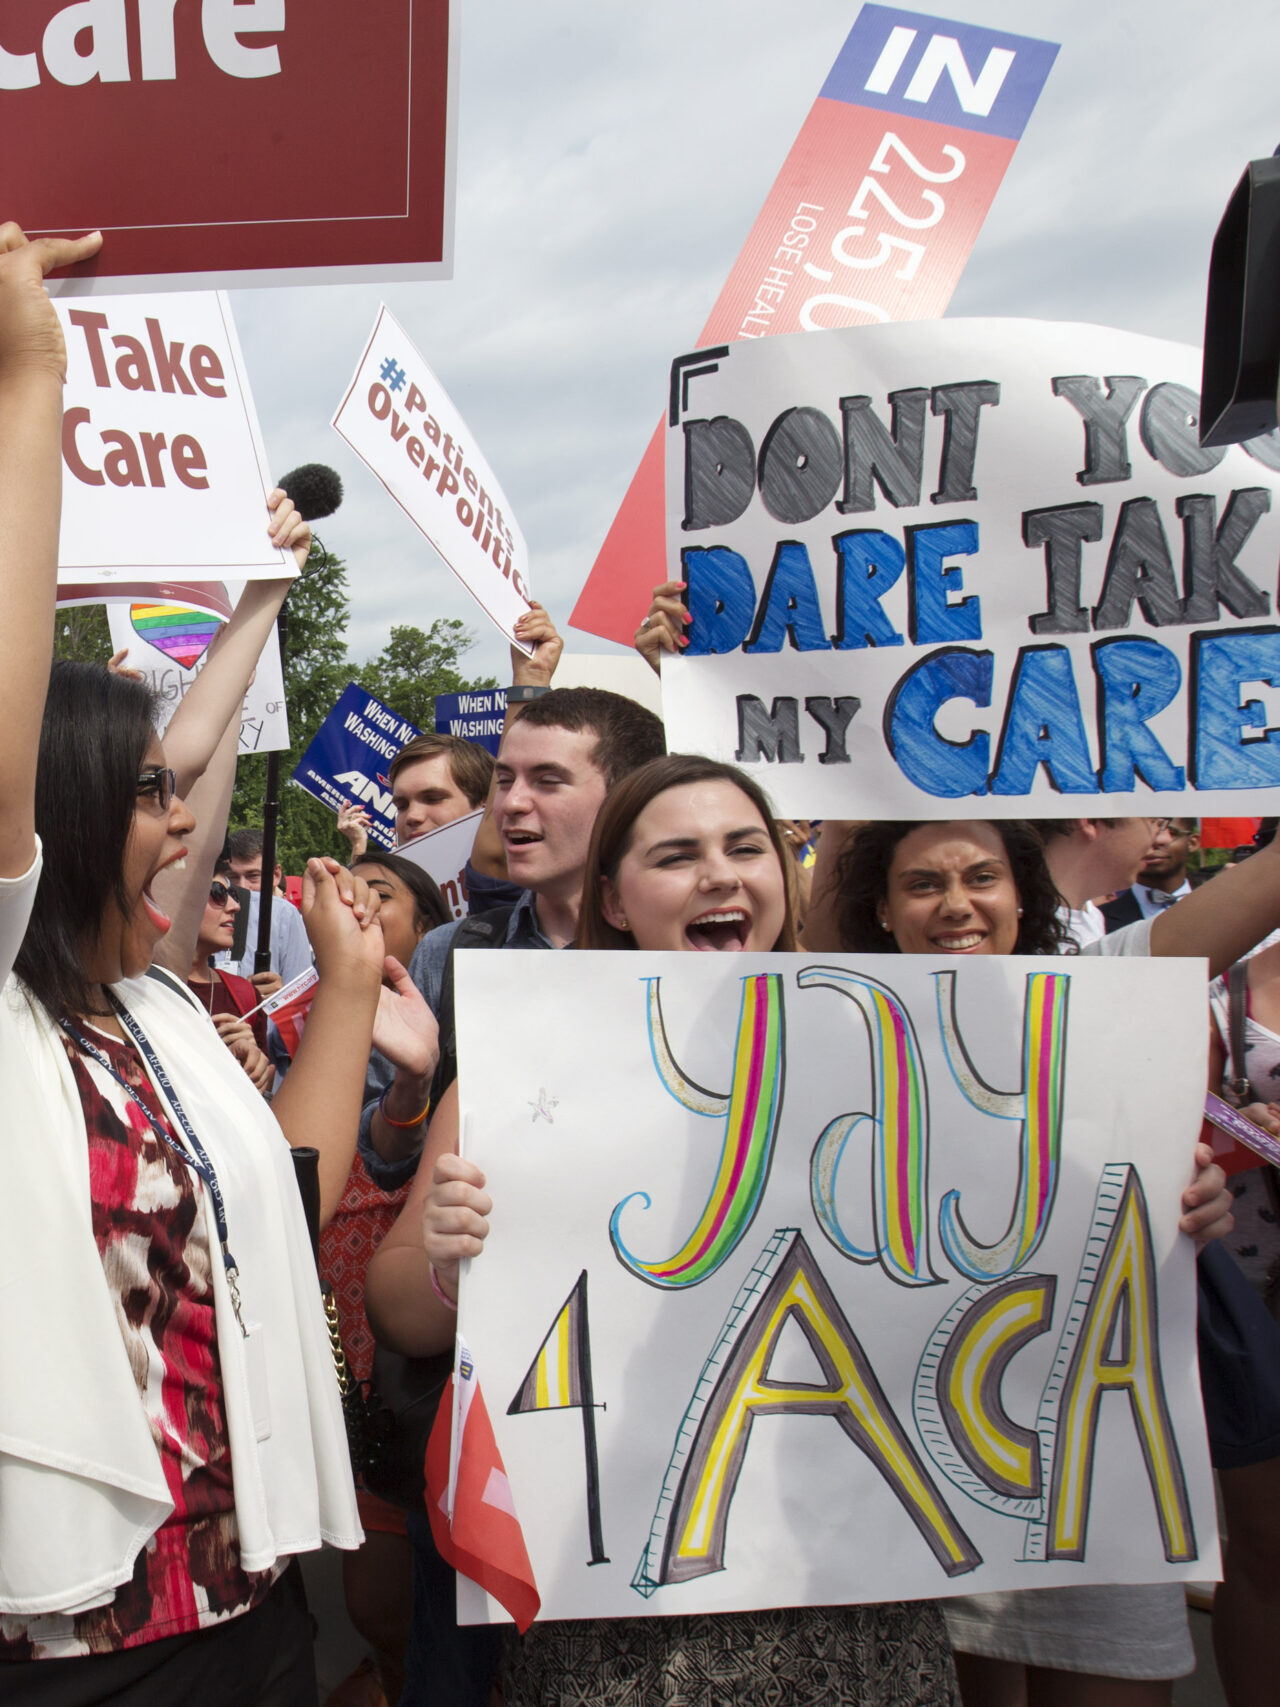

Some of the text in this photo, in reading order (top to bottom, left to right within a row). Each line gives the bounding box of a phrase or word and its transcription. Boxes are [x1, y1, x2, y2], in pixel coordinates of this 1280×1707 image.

[863, 25, 1017, 118] IN
[774, 201, 825, 265] LOSE
[67, 308, 228, 399] Take
[61, 406, 210, 490] Care
[379, 356, 516, 553] #Patients
[682, 378, 1001, 531] DONT
[678, 487, 1280, 657] DARE TAK
[265, 701, 283, 715] OF
[344, 711, 401, 760] WASHING
[363, 699, 396, 734] WHEN
[458, 695, 491, 714] WHEN
[734, 624, 1280, 799] MY CARE
[122, 1012, 147, 1044] AFL-CIO
[146, 1052, 171, 1088] AFL-CIO
[170, 1098, 196, 1137] AFL-CIO
[506, 1162, 1200, 1599] 4 ACA
